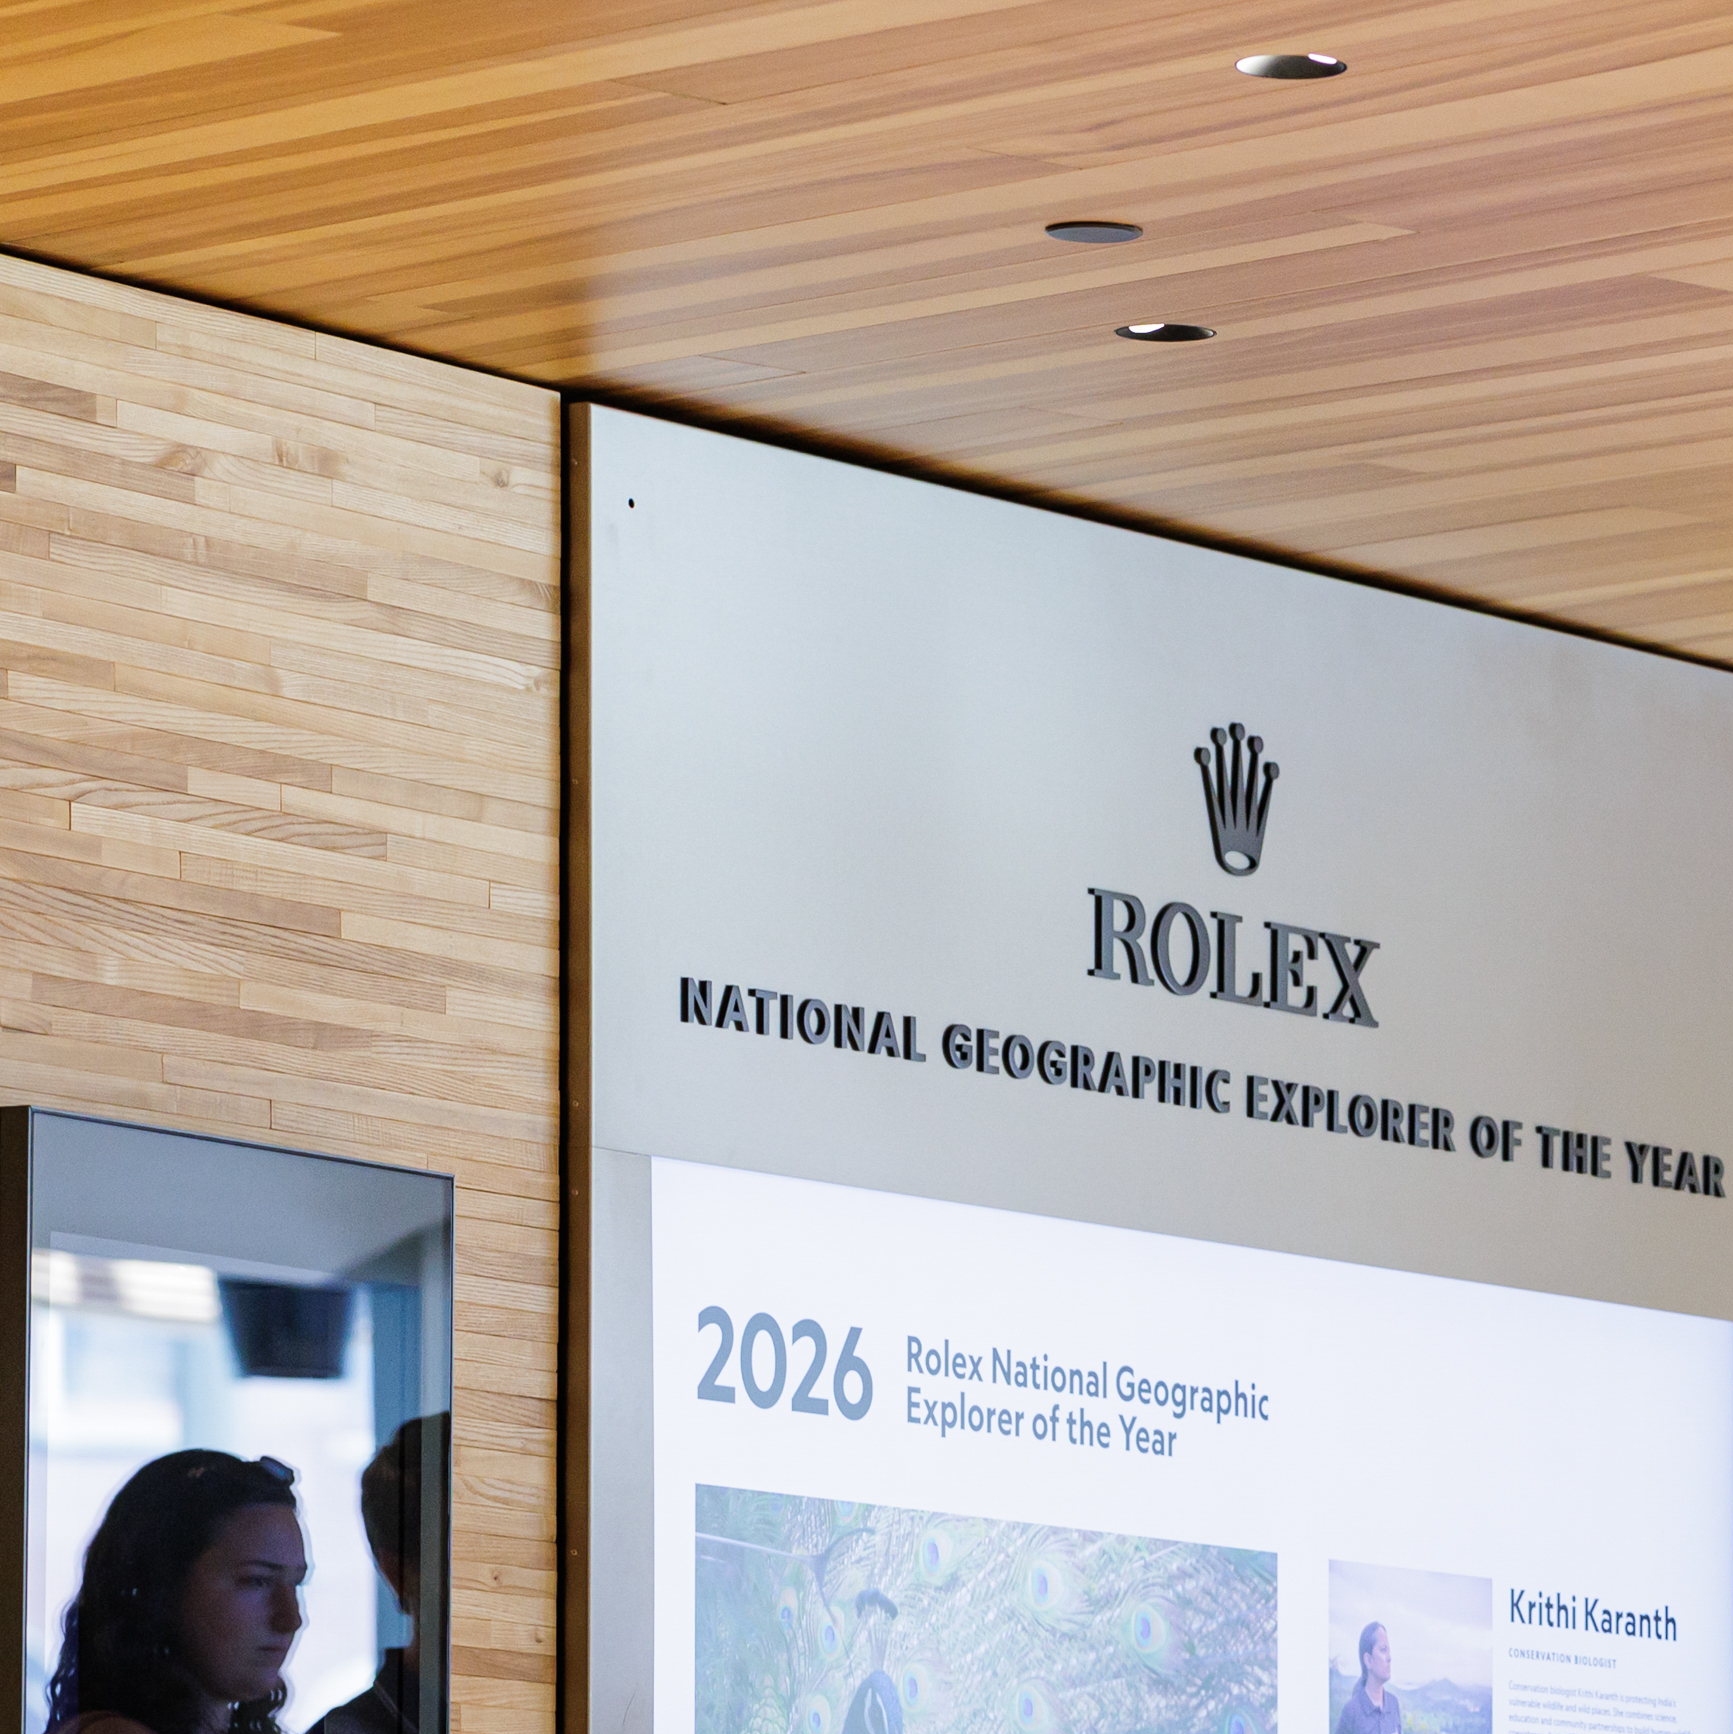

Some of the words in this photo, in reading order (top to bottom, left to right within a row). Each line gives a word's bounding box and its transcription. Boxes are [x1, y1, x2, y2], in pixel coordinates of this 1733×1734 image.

[1088, 888, 1379, 1027] ROLEX
[681, 978, 925, 1061] NATIONAL
[942, 1025, 1229, 1113] GEOGRAPHIC
[1247, 1076, 1452, 1151] EXPLORER
[1470, 1116, 1521, 1161] OF
[1536, 1126, 1610, 1177] THE
[1625, 1142, 1724, 1197] YEAR
[698, 1306, 873, 1420] 2026
[908, 1336, 982, 1381] Rolex
[993, 1348, 1107, 1398] National
[1116, 1366, 1268, 1424] Geographic
[908, 1386, 1024, 1437] Explorer
[1033, 1404, 1059, 1441] of
[1067, 1408, 1110, 1448] the
[1119, 1415, 1176, 1456] Year
[1509, 1648, 1571, 1663] CONSERVATION
[1574, 1655, 1616, 1668] BIOLOGIST
[1511, 1589, 1575, 1629] Krithi
[1585, 1598, 1676, 1641] Karanth
